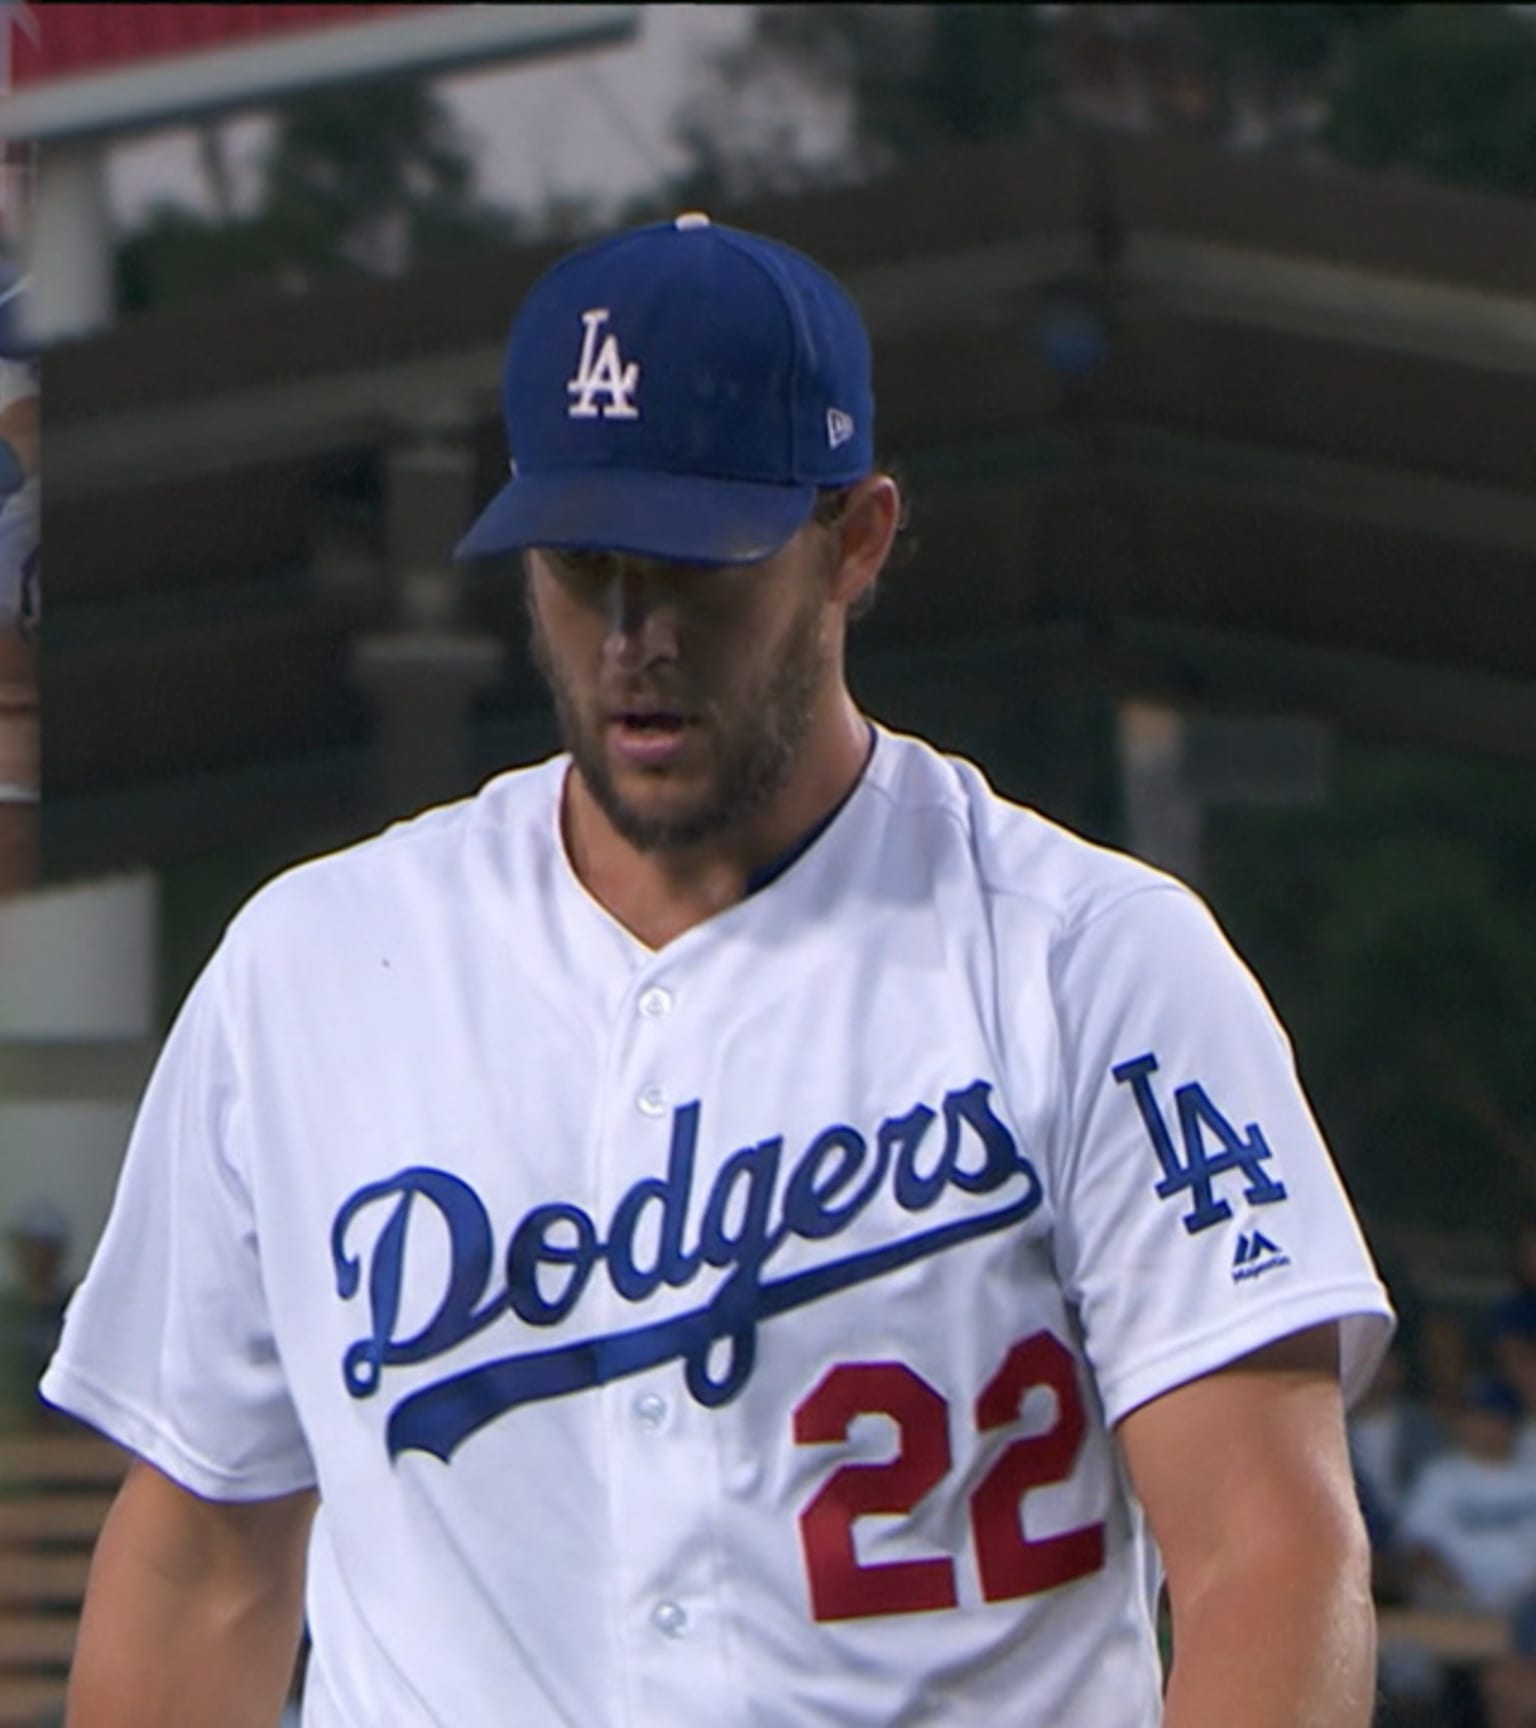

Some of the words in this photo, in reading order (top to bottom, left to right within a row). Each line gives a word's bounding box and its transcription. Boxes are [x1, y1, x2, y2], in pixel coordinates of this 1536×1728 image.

[568, 309, 639, 418] LA
[332, 1080, 1043, 1408] Dodgers
[1112, 1053, 1287, 1234] LA
[792, 1329, 1107, 1623] 22
